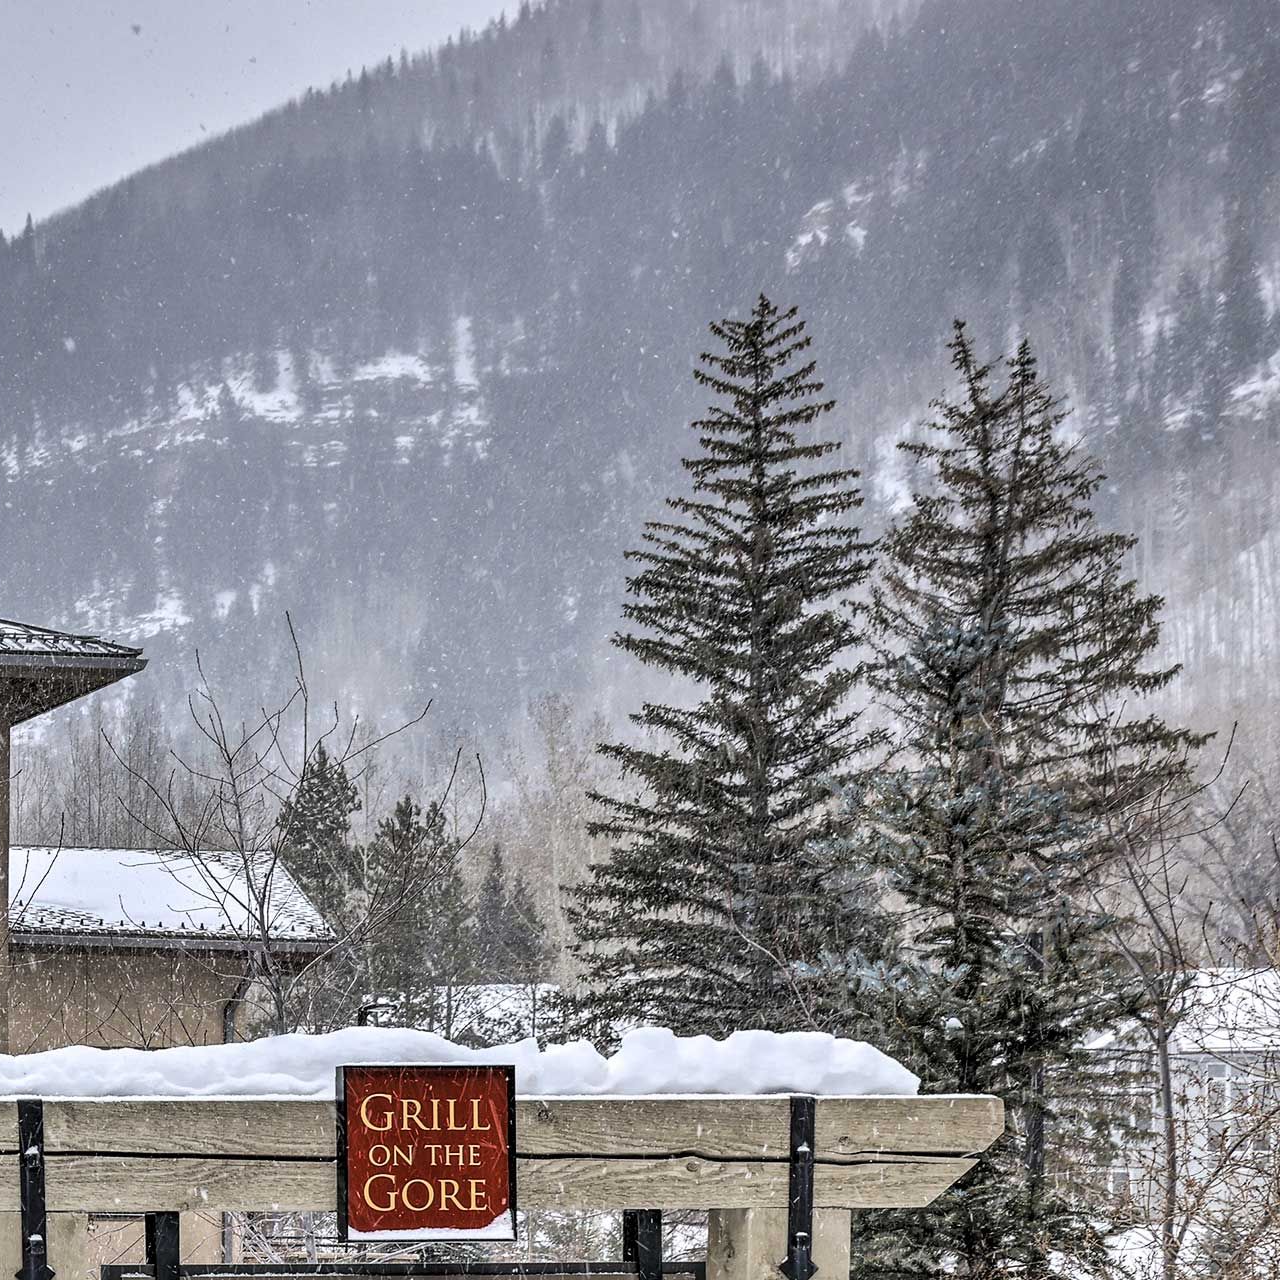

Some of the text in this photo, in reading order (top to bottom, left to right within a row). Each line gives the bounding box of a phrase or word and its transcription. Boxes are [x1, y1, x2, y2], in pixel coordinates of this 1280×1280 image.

[360, 1093, 491, 1131] GRILL
[368, 1144, 482, 1167] ON THE
[363, 1173, 488, 1212] GORE
